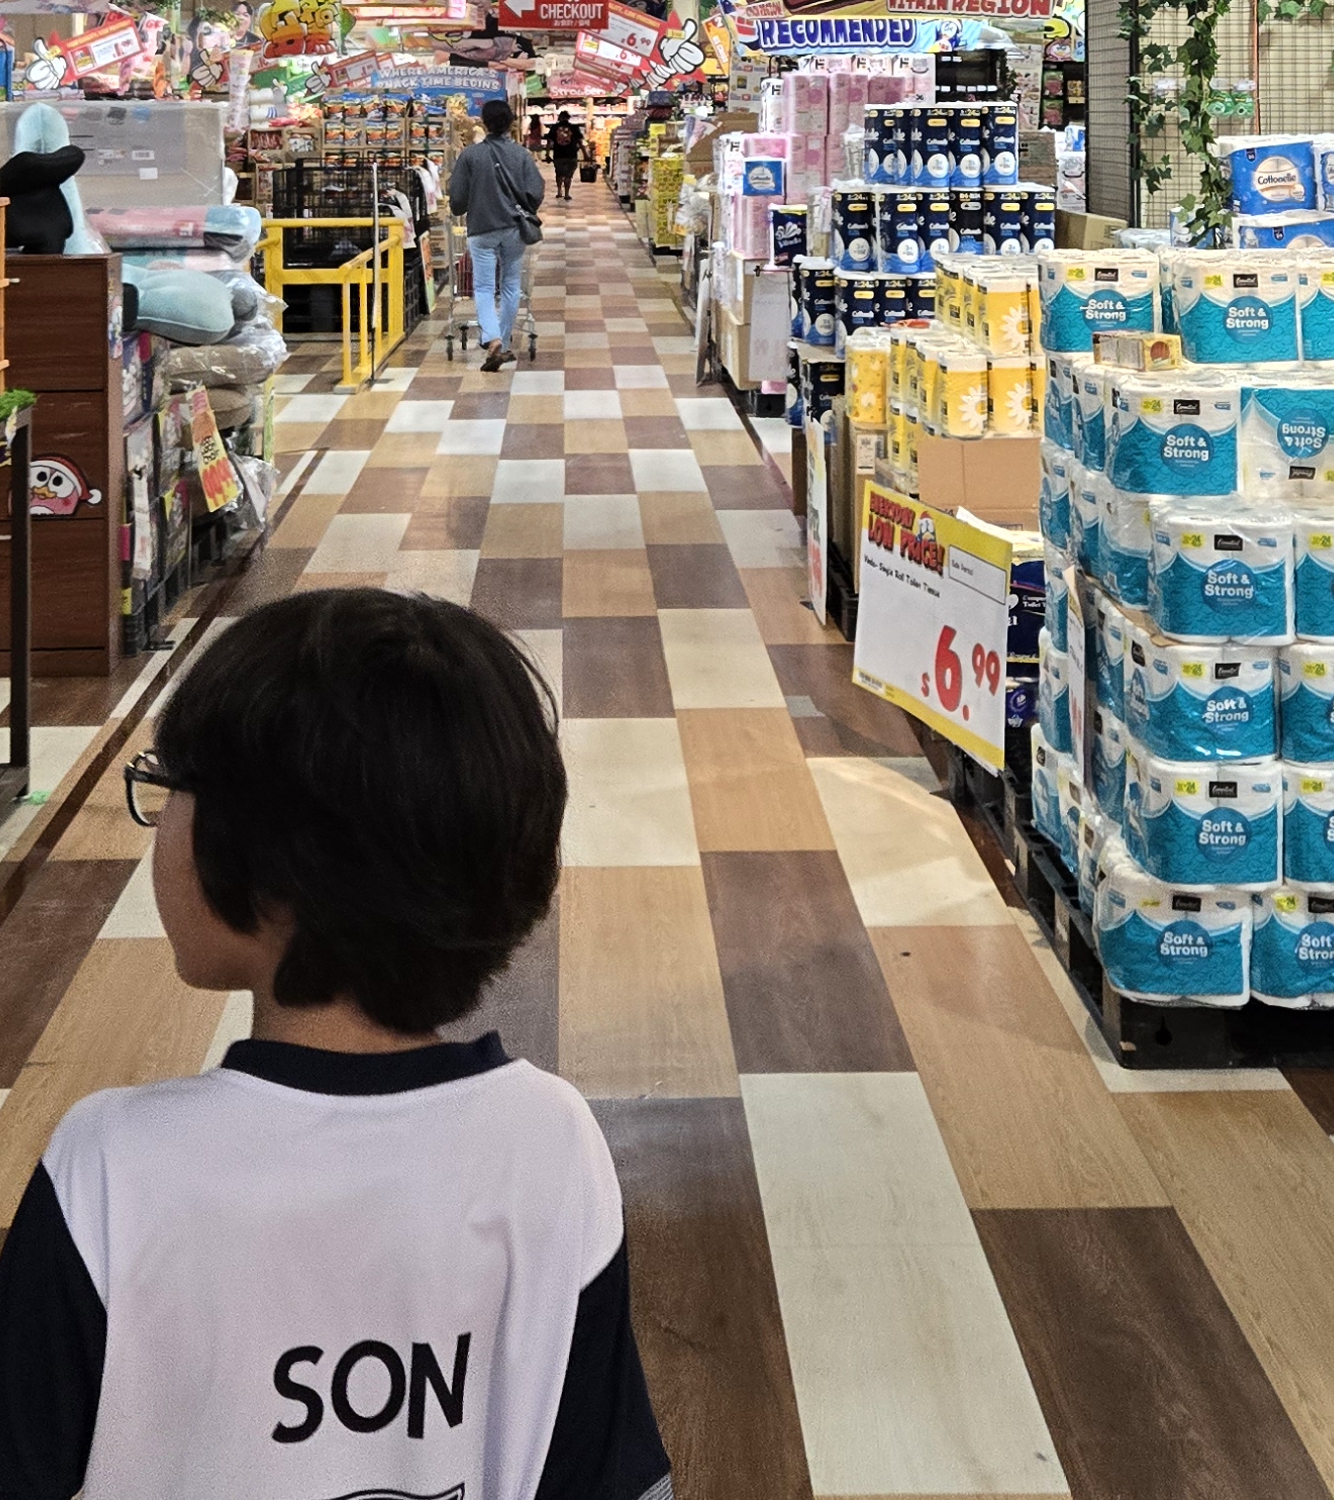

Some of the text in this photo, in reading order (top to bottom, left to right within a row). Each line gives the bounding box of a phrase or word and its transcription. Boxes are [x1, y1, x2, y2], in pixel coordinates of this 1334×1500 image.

[540, 3, 605, 20] CHECKOUT
[760, 19, 917, 49] RECOMMENDED
[378, 66, 424, 79] WHERE
[1228, 306, 1255, 318] Soft
[1226, 317, 1269, 330] Strong
[1166, 435, 1196, 447] Soft
[1163, 446, 1210, 462] Strong
[868, 513, 946, 577] LOW PRICE!
[1201, 819, 1232, 832] Soft
[1198, 832, 1246, 846] Strong
[271, 1331, 472, 1444] SON
